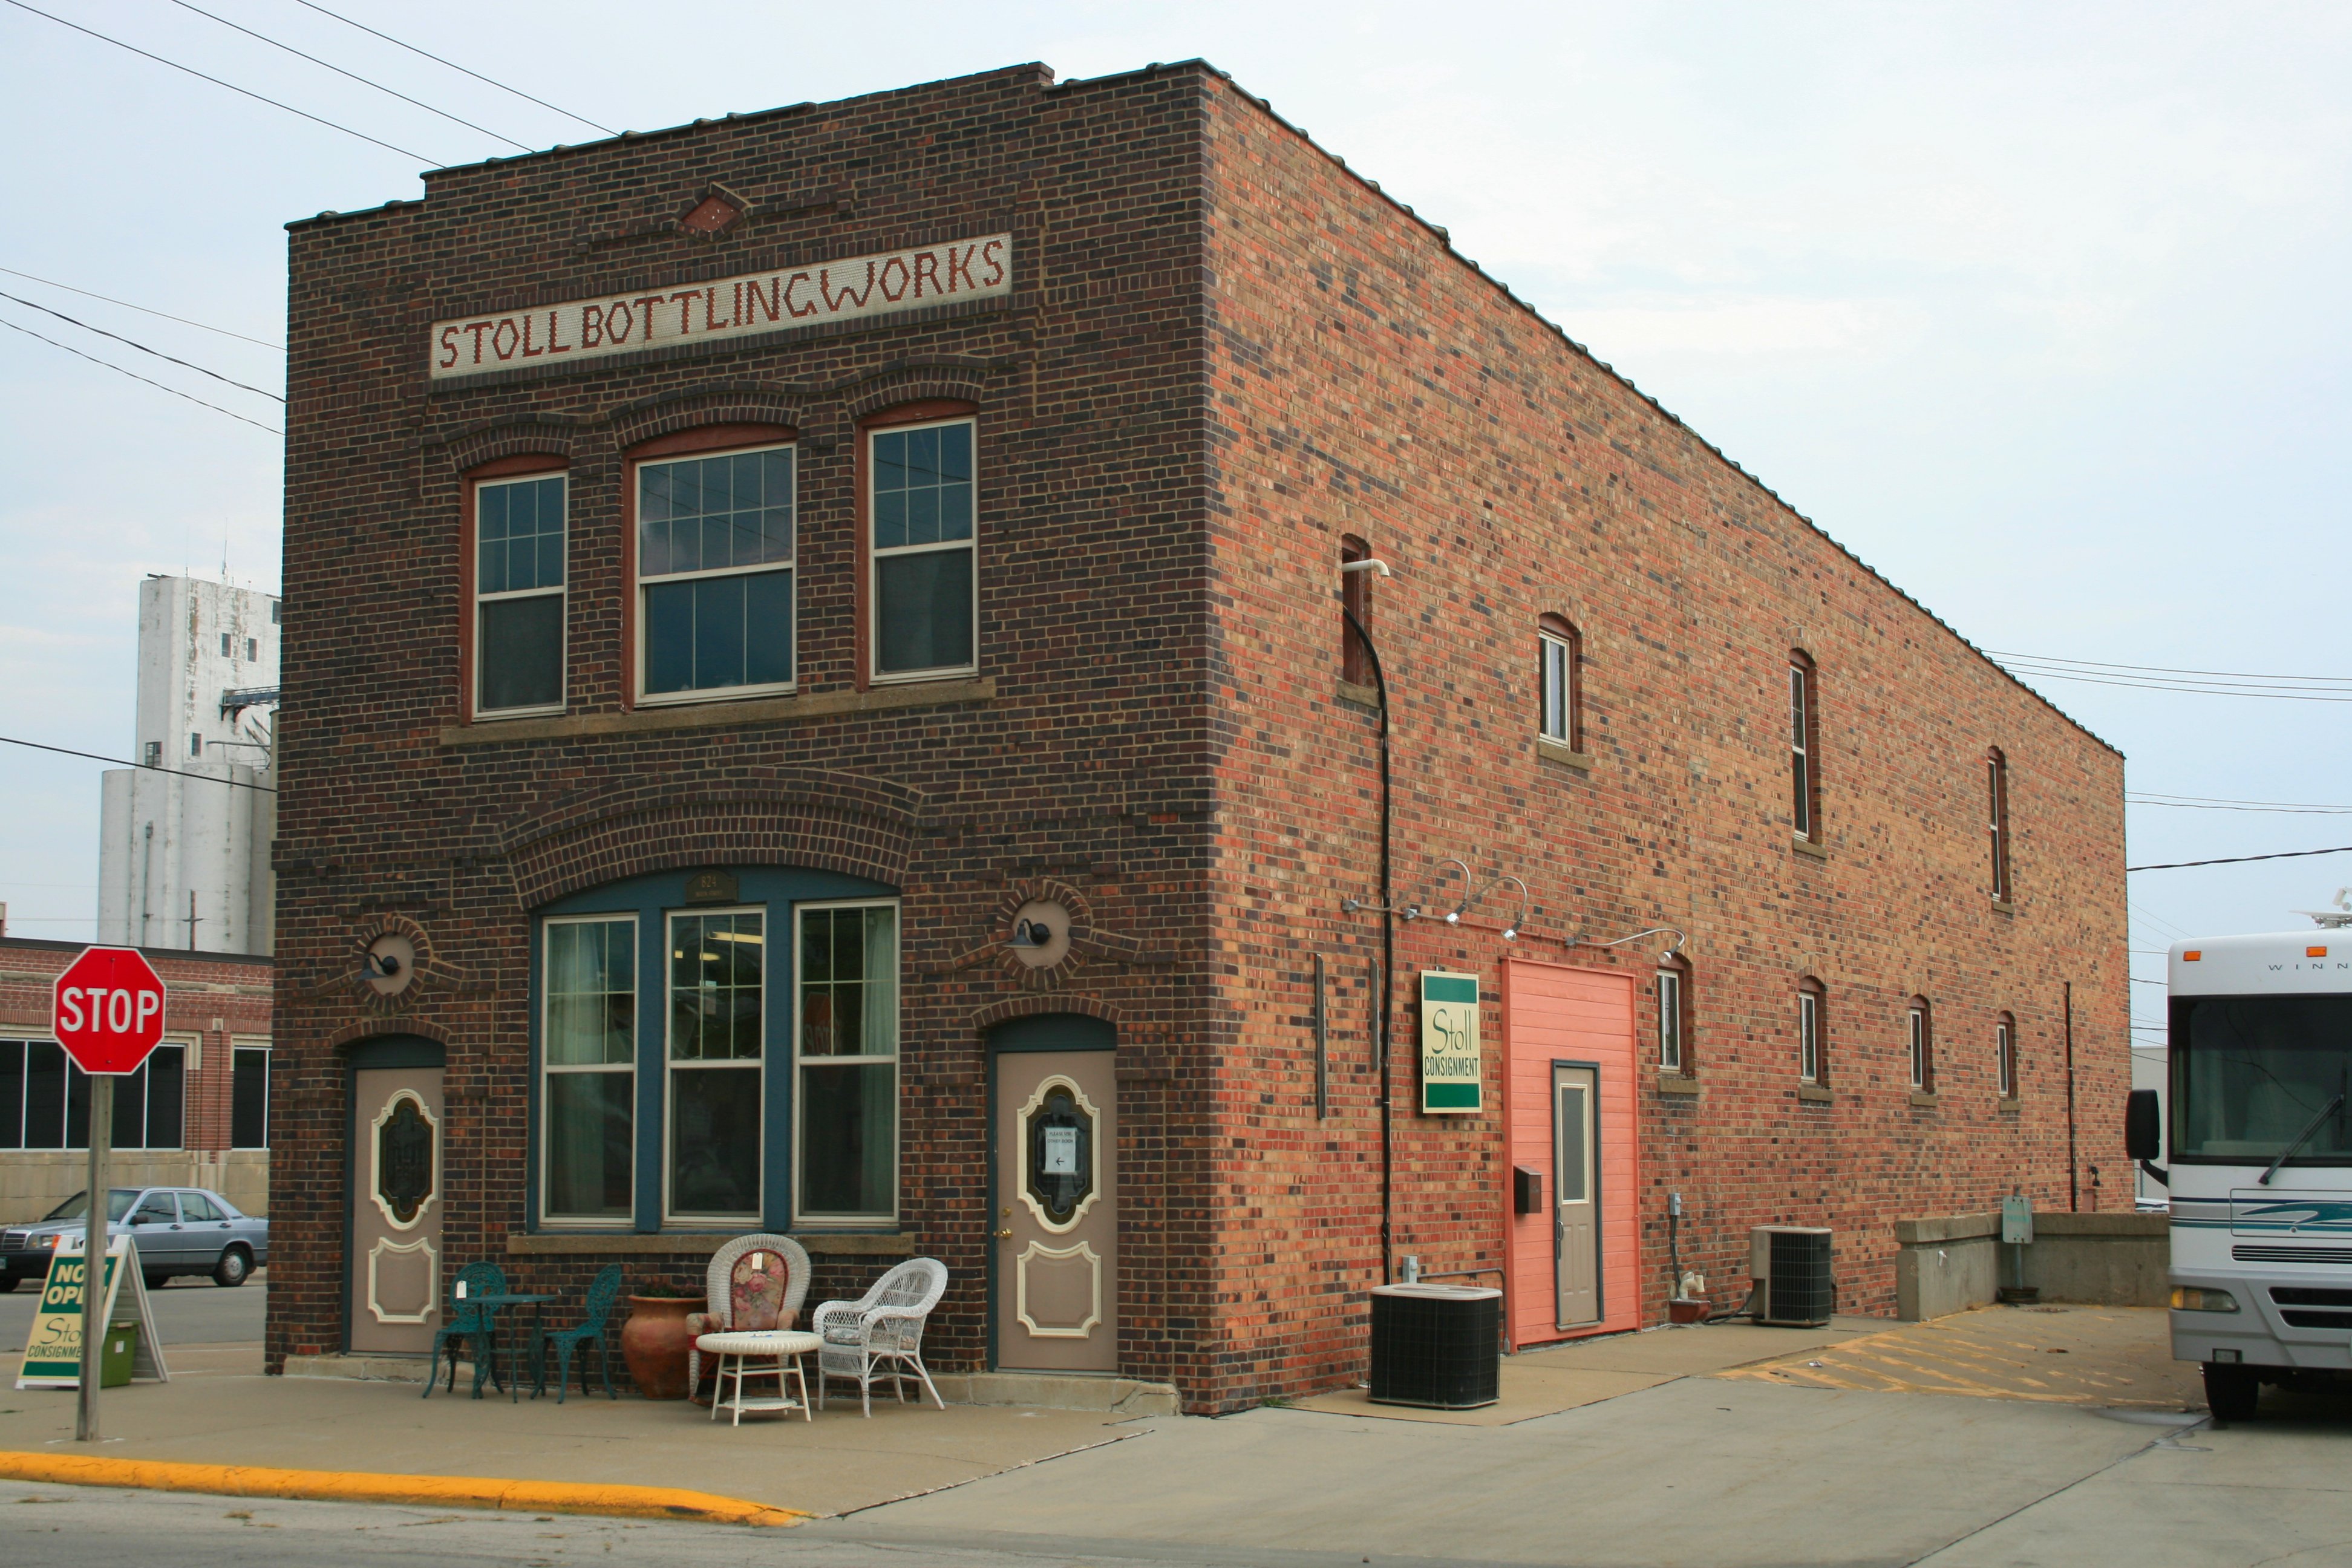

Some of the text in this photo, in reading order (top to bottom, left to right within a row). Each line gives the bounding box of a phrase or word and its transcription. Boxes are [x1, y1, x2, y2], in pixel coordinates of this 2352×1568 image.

[439, 240, 1004, 368] STOLL BOTTLING WORKS
[2269, 962, 2348, 971] WINN
[60, 987, 159, 1033] STOP
[1431, 1008, 1472, 1054] Stoll
[1425, 1056, 1478, 1077] CONSIGNMENT
[40, 1318, 82, 1345] Sto
[28, 1345, 81, 1358] CONSIGNME
